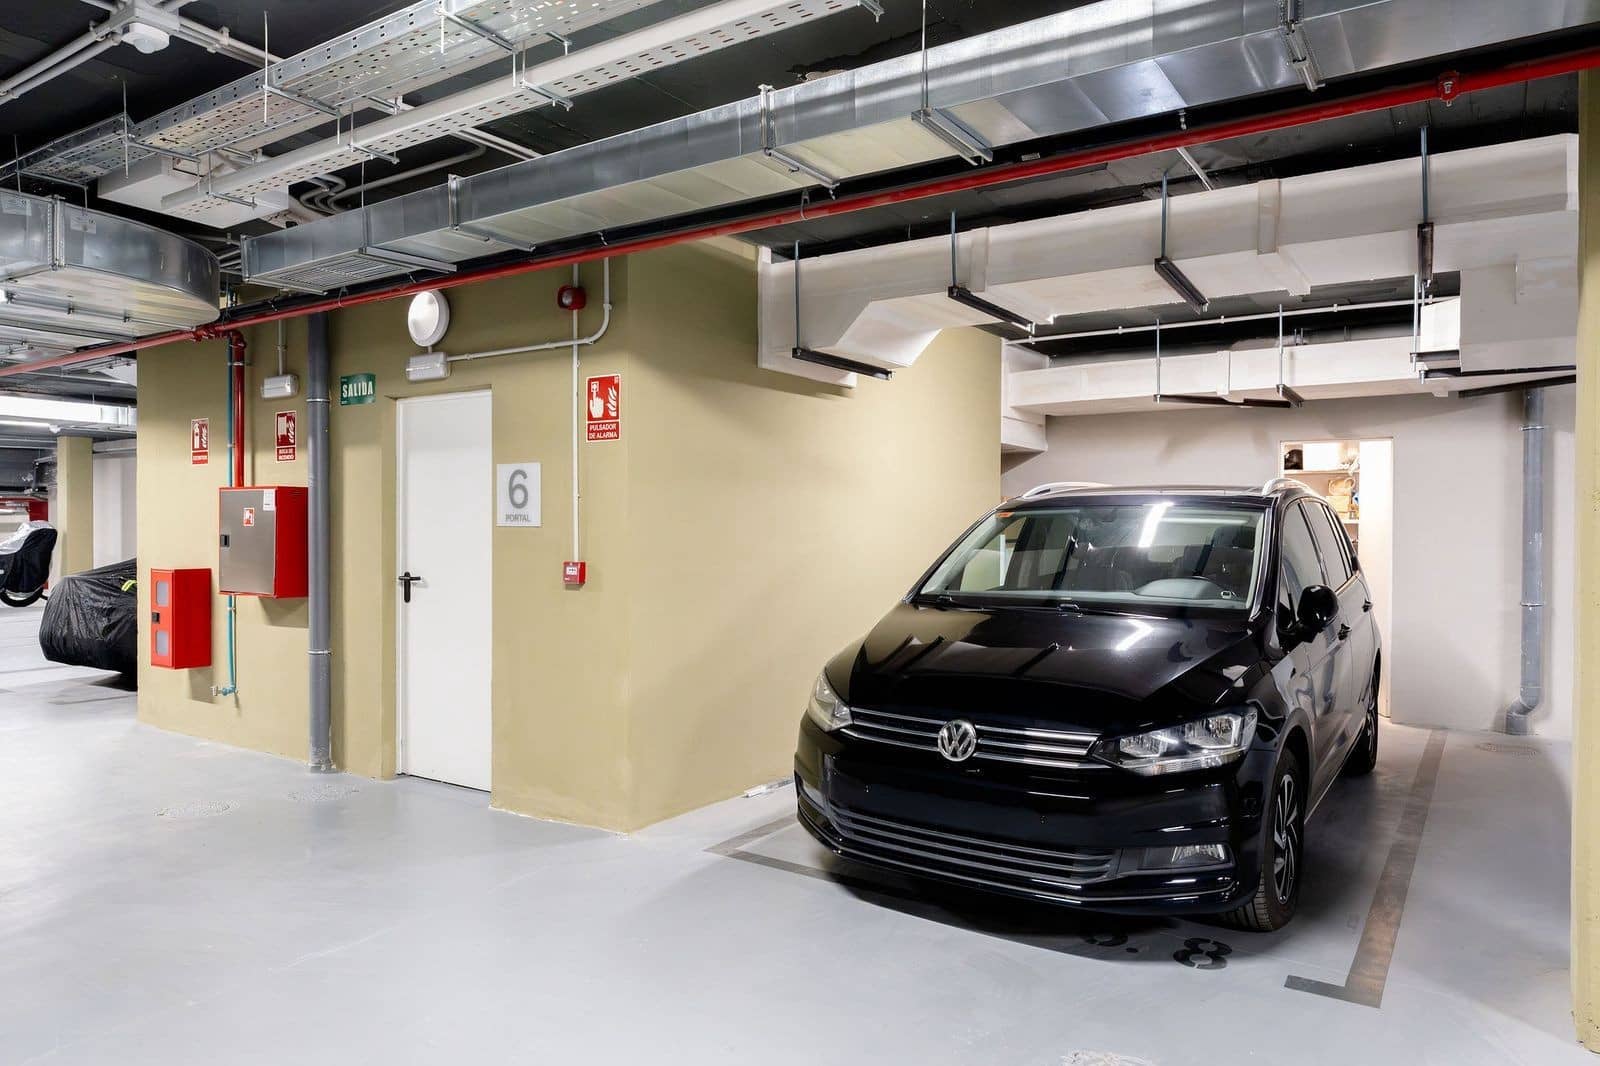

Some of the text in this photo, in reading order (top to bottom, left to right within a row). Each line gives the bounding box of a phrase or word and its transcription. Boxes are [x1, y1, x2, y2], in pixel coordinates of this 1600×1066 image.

[342, 381, 373, 398] SALIDA
[589, 423, 617, 431] PULSADOR
[597, 431, 617, 439] ALARMA
[508, 469, 529, 509] 6
[505, 514, 530, 522] PORTAL
[1173, 937, 1232, 970] 8
